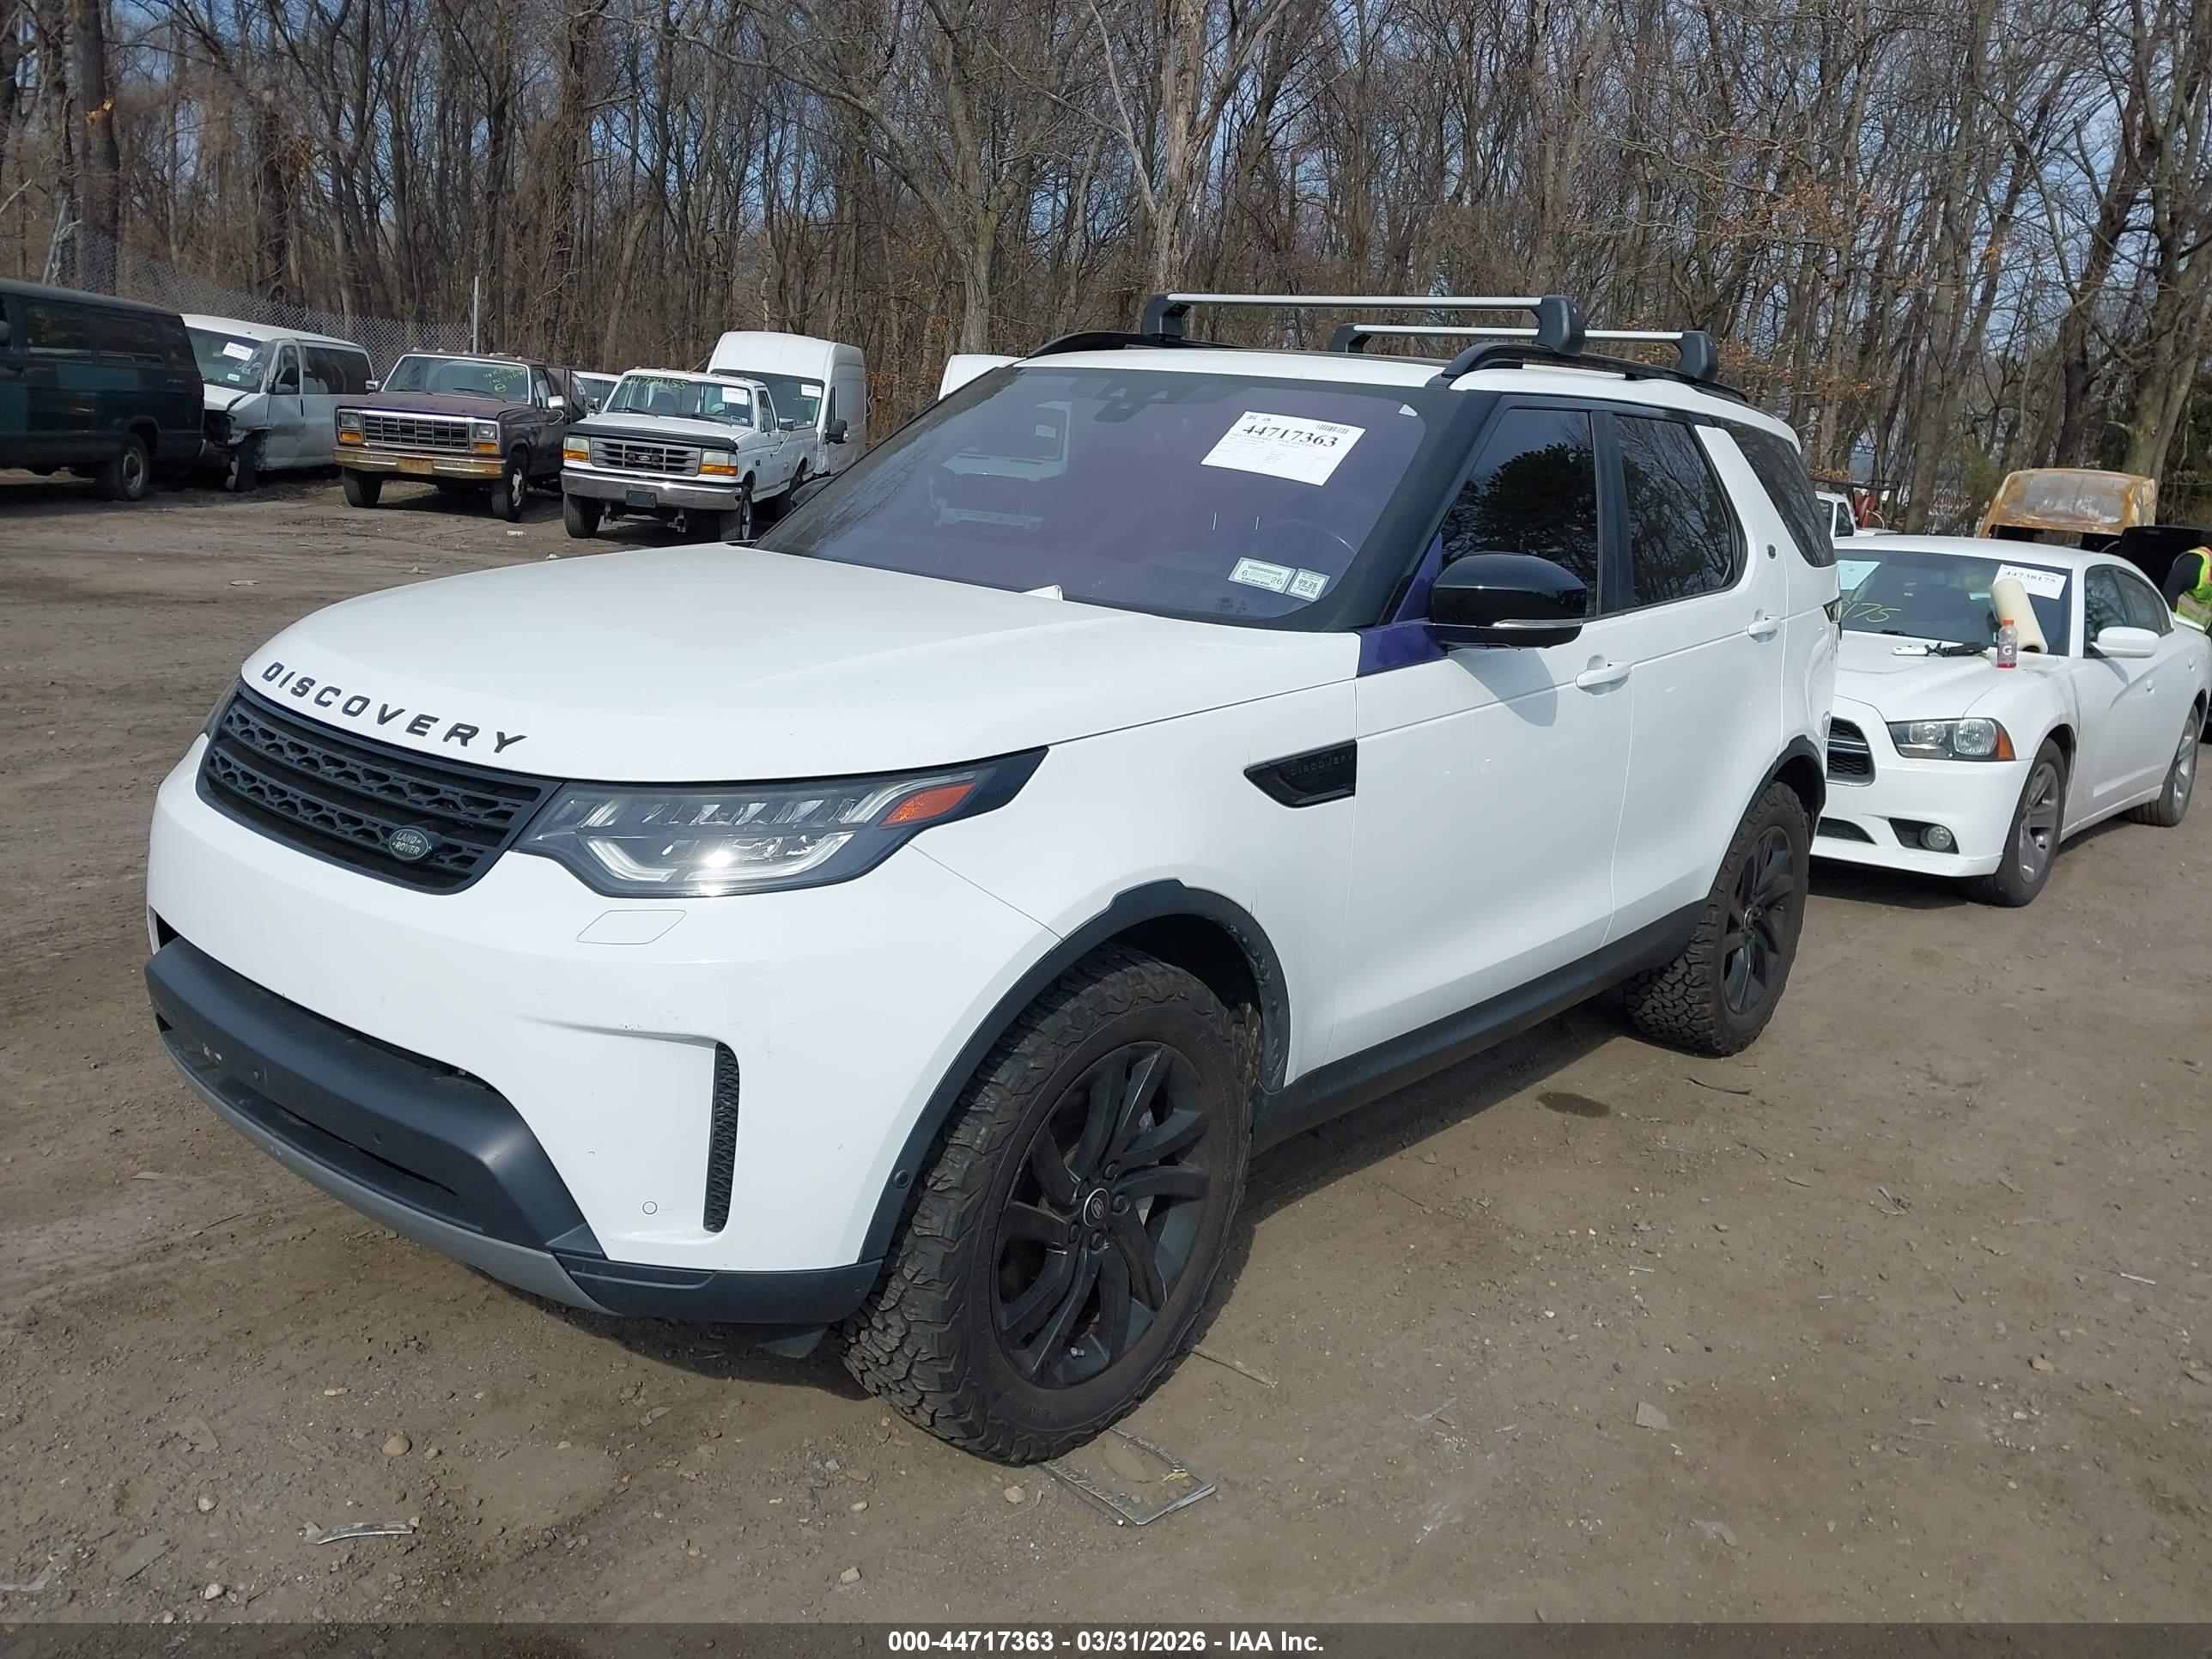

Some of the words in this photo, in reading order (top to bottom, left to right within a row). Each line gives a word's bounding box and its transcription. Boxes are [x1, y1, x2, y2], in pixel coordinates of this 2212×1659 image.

[1243, 424, 1339, 447] 44717363
[1270, 576, 1284, 586] 26
[1843, 600, 1902, 623] 175
[2002, 645, 2012, 656] G
[261, 661, 528, 754] DISCOVERY
[396, 831, 417, 845] LAND
[394, 841, 421, 856] ROVER
